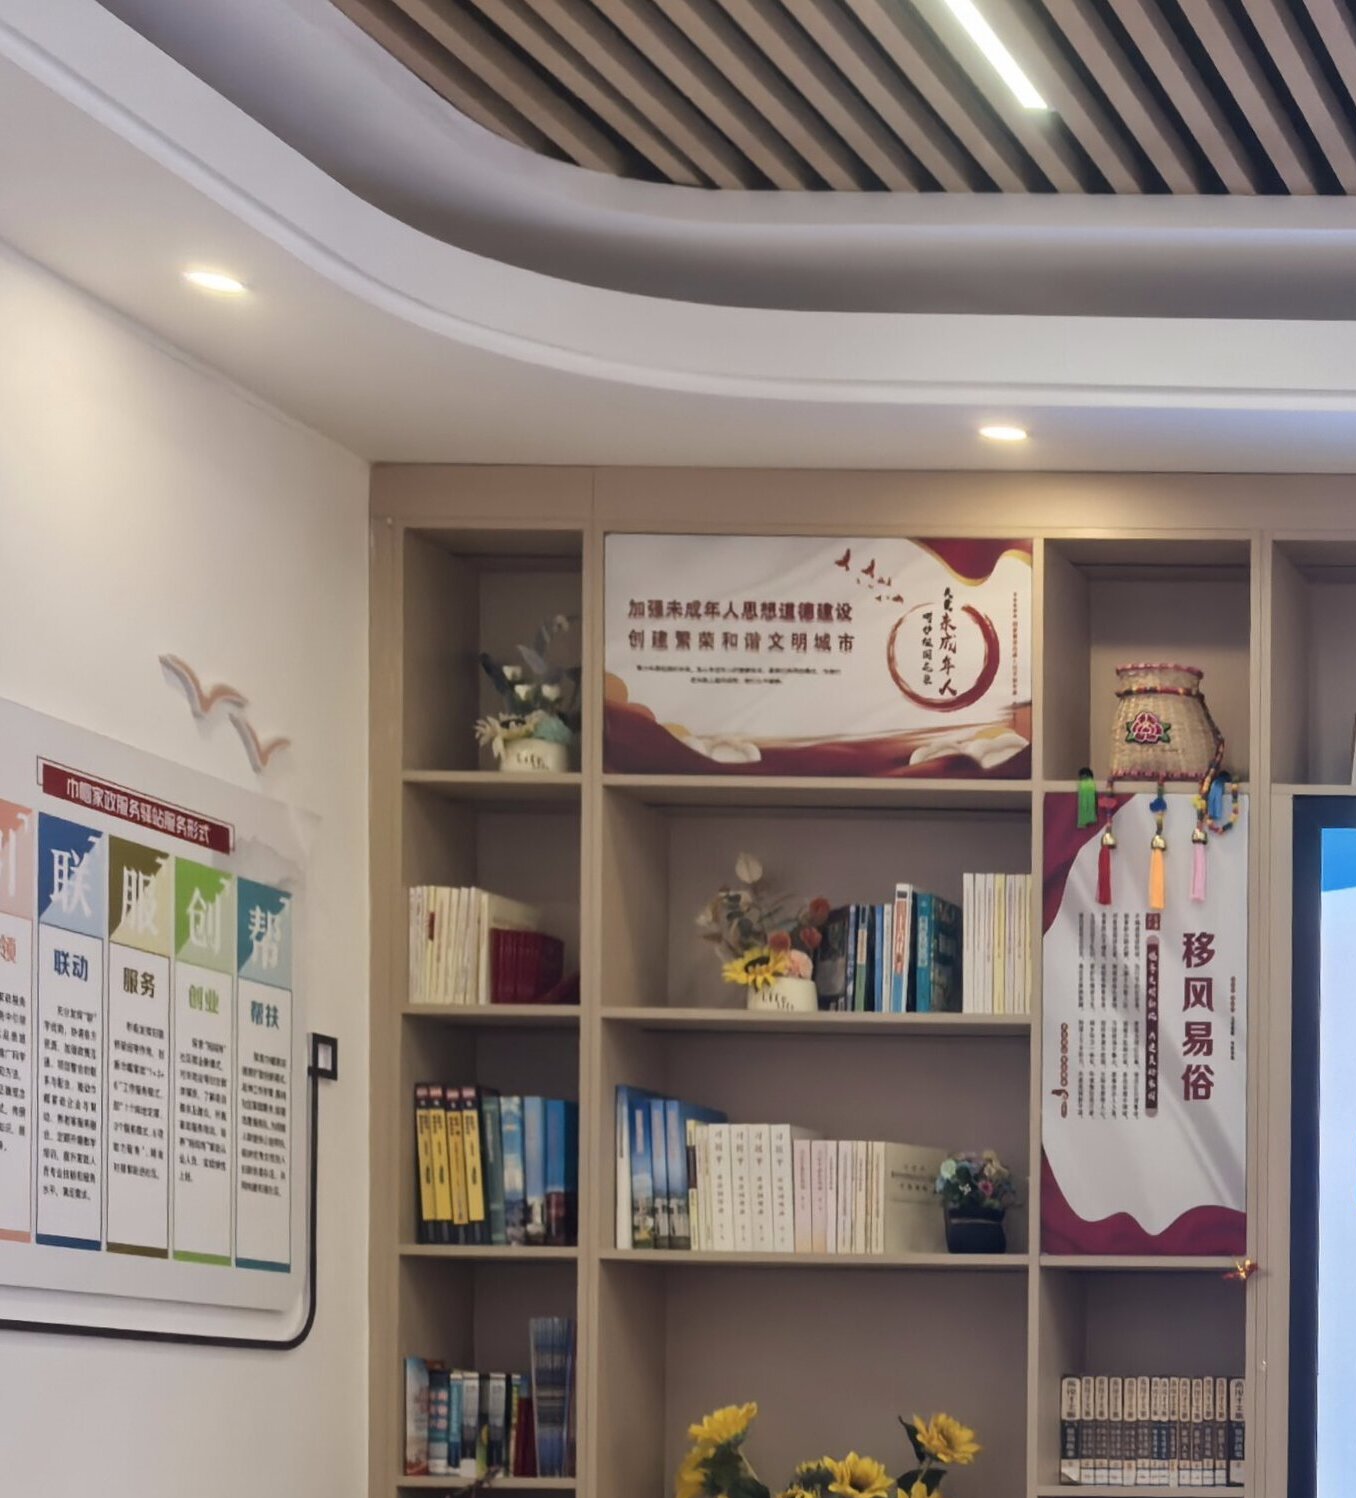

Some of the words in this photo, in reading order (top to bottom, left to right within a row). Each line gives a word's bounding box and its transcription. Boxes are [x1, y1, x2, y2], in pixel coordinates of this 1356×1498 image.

[627, 598, 853, 624] 加强未成年人思想道德建设
[627, 629, 855, 653] 创建繁荣和谐文明城市
[50, 848, 92, 916] 联
[121, 865, 158, 935] 服
[186, 886, 222, 955] 创
[248, 905, 282, 970] 帮
[53, 949, 89, 982] 联动
[123, 967, 156, 998] 服务
[188, 984, 220, 1014] 创业
[251, 1000, 280, 1029] 帮扶
[1181, 931, 1215, 1101] 移风易俗
